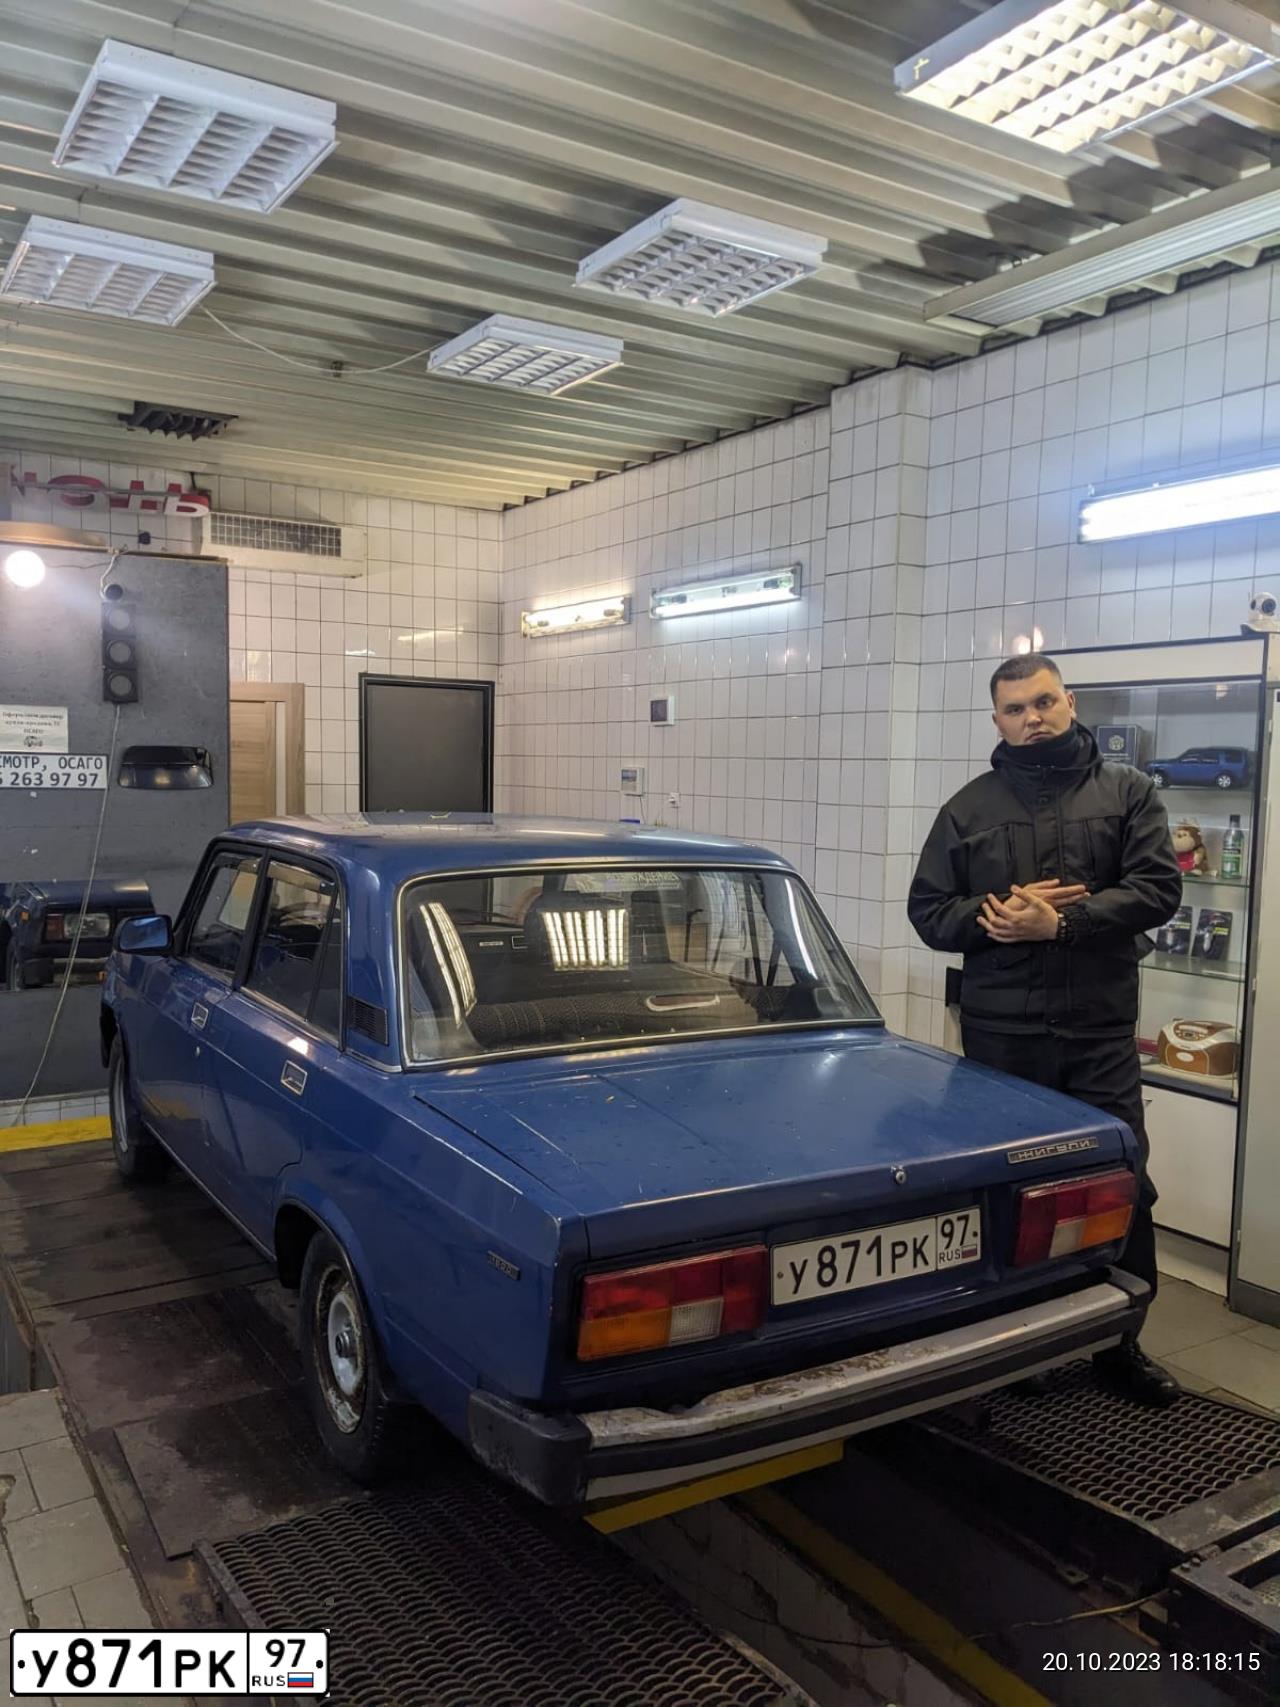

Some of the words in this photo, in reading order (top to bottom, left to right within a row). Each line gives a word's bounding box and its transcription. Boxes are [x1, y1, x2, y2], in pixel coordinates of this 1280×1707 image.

[0, 756, 47, 772] МОТР,
[58, 757, 103, 770] ОСАГО
[10, 772, 44, 786] 263
[50, 773, 71, 787] 97
[77, 773, 98, 787] 97
[789, 1235, 929, 1295] У871РК
[940, 1214, 970, 1249] 97
[939, 1249, 961, 1263] RUS
